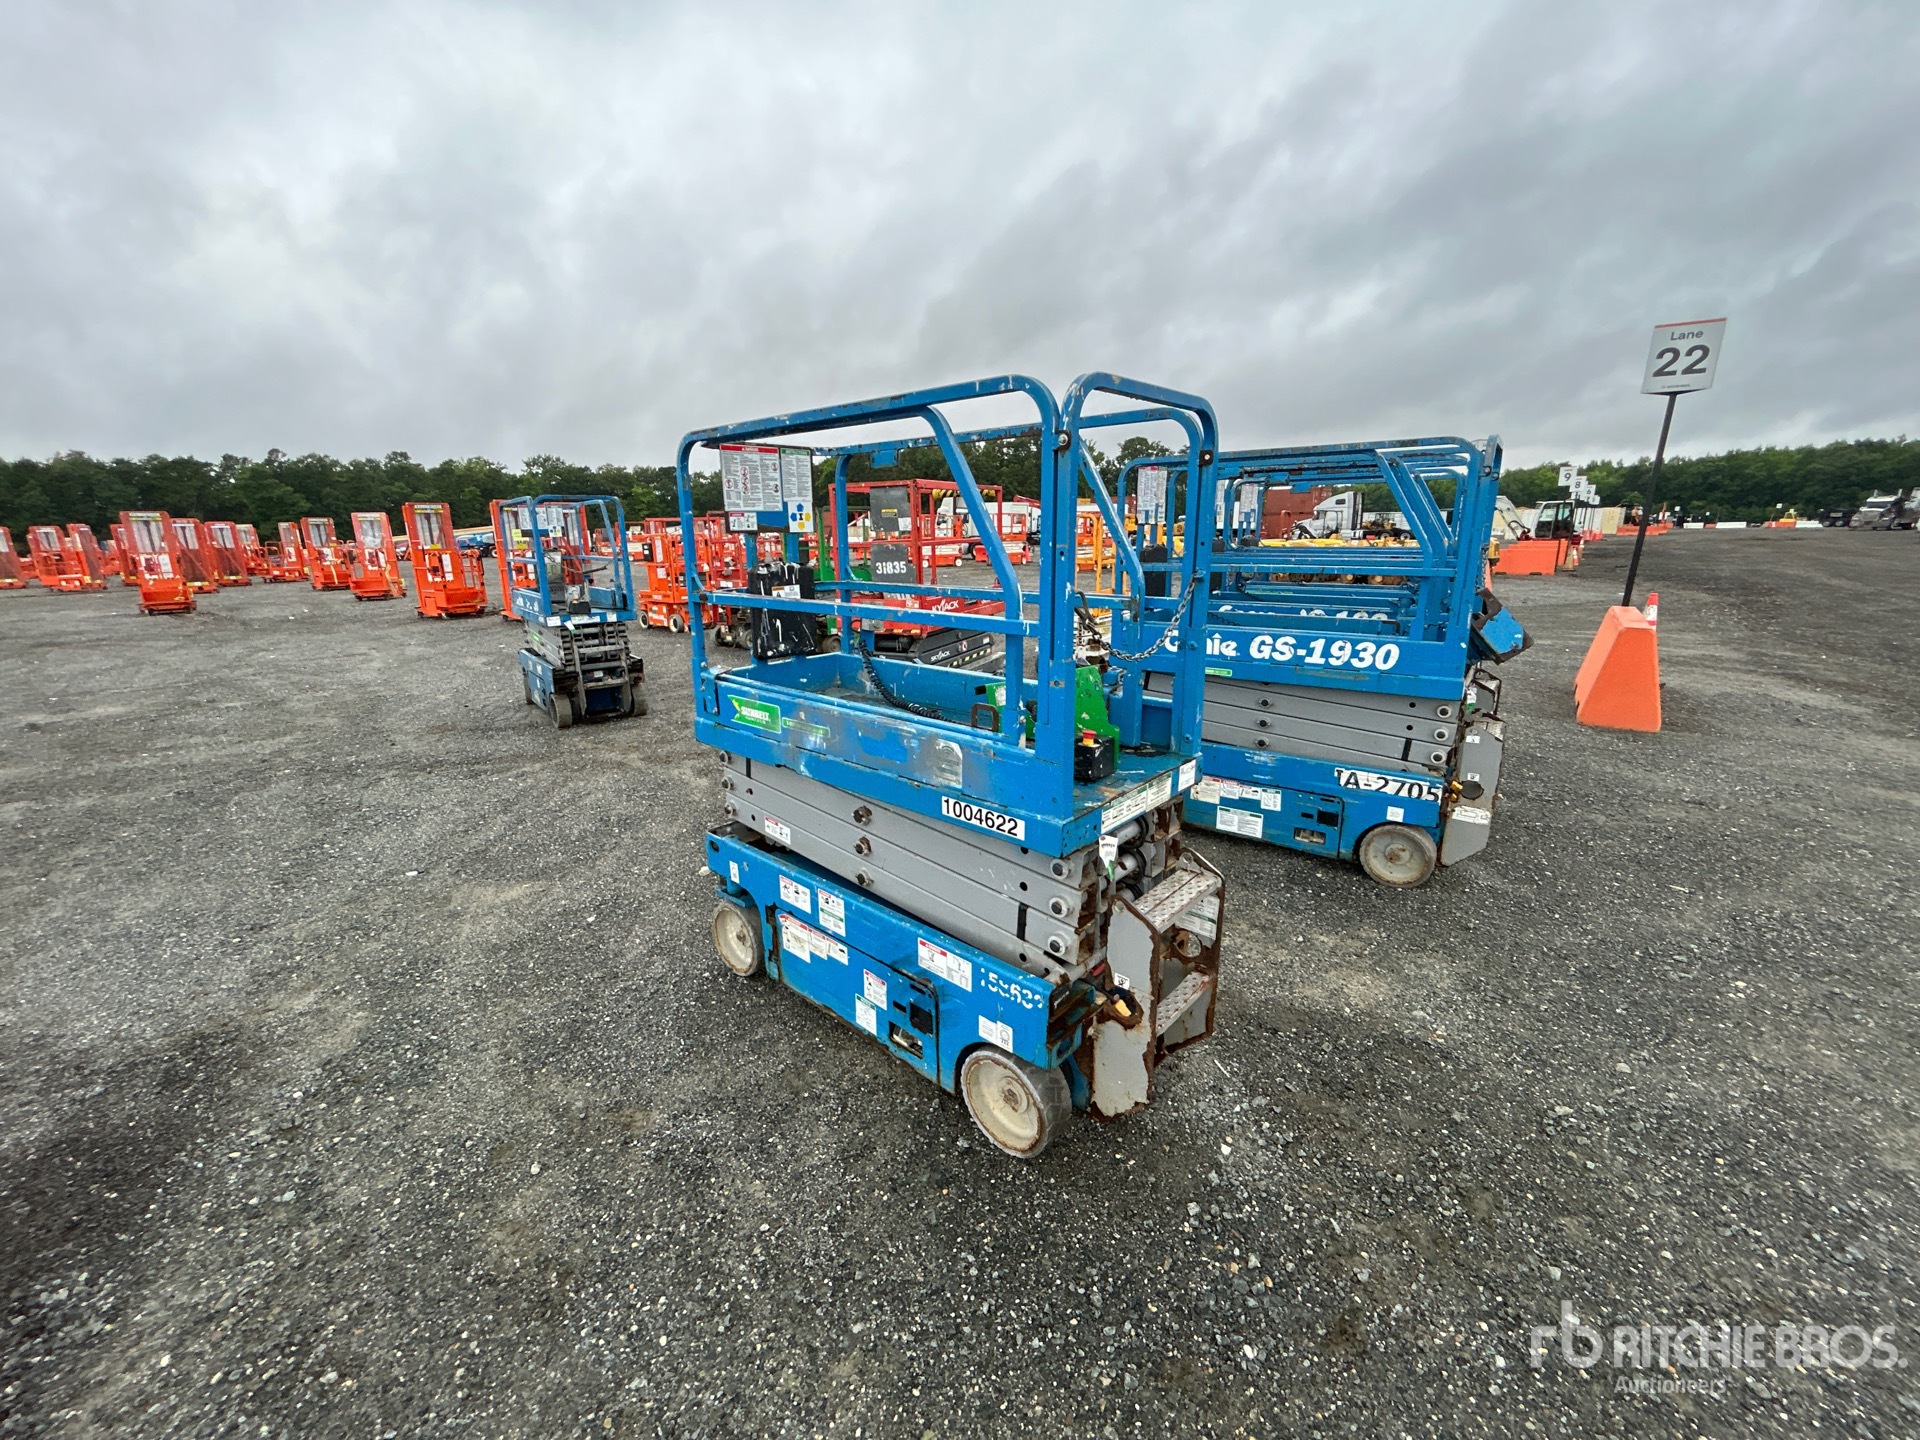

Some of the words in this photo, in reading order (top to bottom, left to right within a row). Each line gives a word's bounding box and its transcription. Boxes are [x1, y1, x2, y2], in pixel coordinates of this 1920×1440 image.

[1670, 330, 1704, 341] Lane
[1652, 344, 1710, 378] 22
[1564, 473, 1571, 481] 9
[875, 561, 907, 575] 31835
[1249, 634, 1400, 671] GS-1930
[741, 706, 770, 721] SUNBELT
[942, 798, 1018, 837] 1004622
